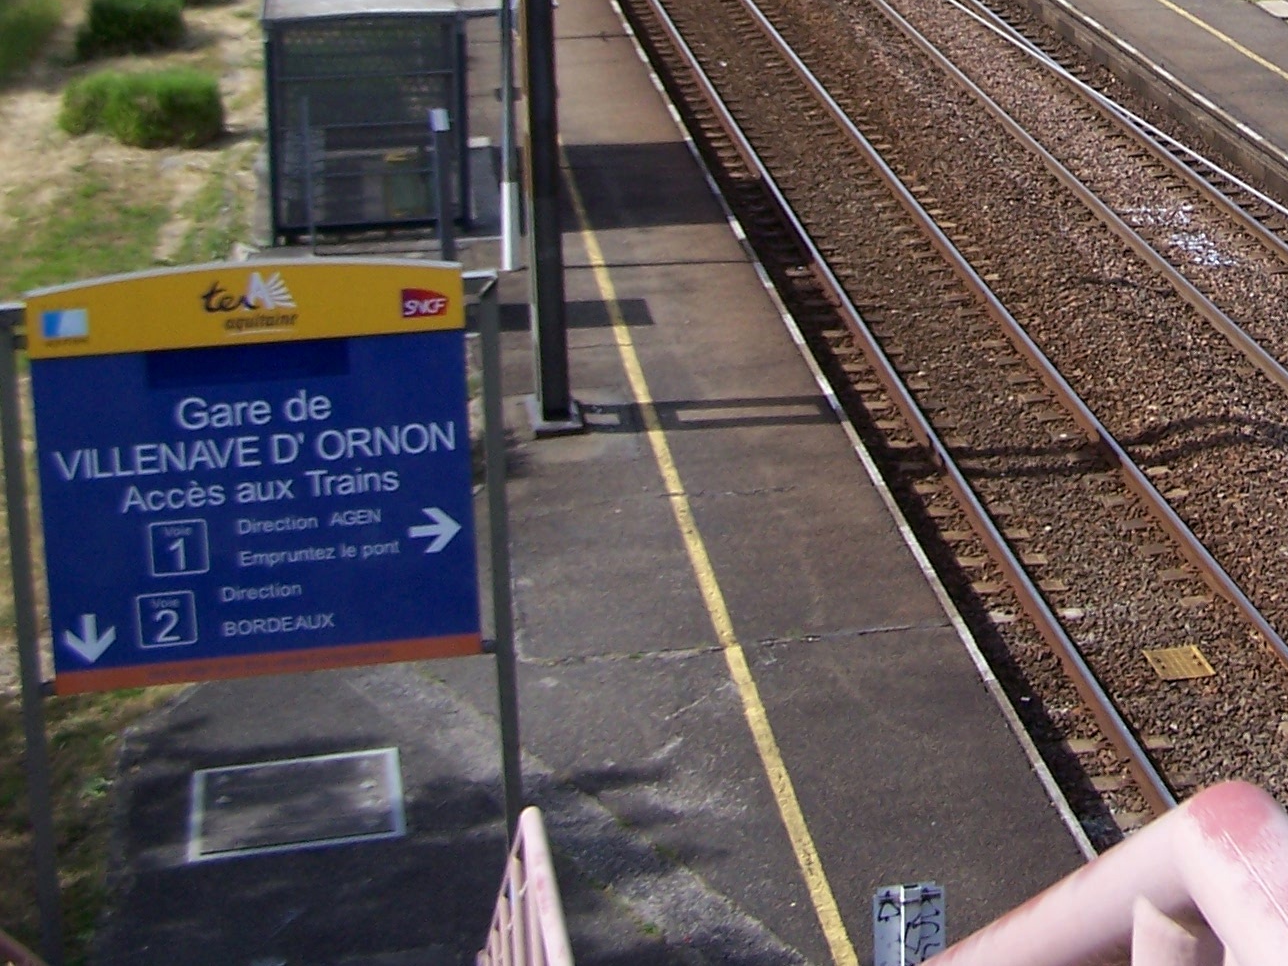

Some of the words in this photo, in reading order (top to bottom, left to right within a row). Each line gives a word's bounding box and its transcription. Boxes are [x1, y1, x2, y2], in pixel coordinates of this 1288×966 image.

[404, 298, 447, 315] SNCF
[176, 397, 271, 430] Gare
[286, 389, 332, 422] de
[54, 435, 261, 481] VILLENAVE
[316, 421, 456, 461] ORNON
[122, 480, 226, 514] Accès
[237, 478, 294, 504] aux
[305, 467, 400, 497] Trains
[238, 514, 319, 535] Direction
[330, 509, 382, 527] AGEN
[168, 538, 187, 570] 1
[240, 544, 336, 568] Empruntez
[341, 543, 357, 558] le
[363, 540, 400, 560] pont
[222, 582, 302, 602] Direction
[154, 609, 182, 643] 2
[223, 612, 336, 637] BORDEAUX
